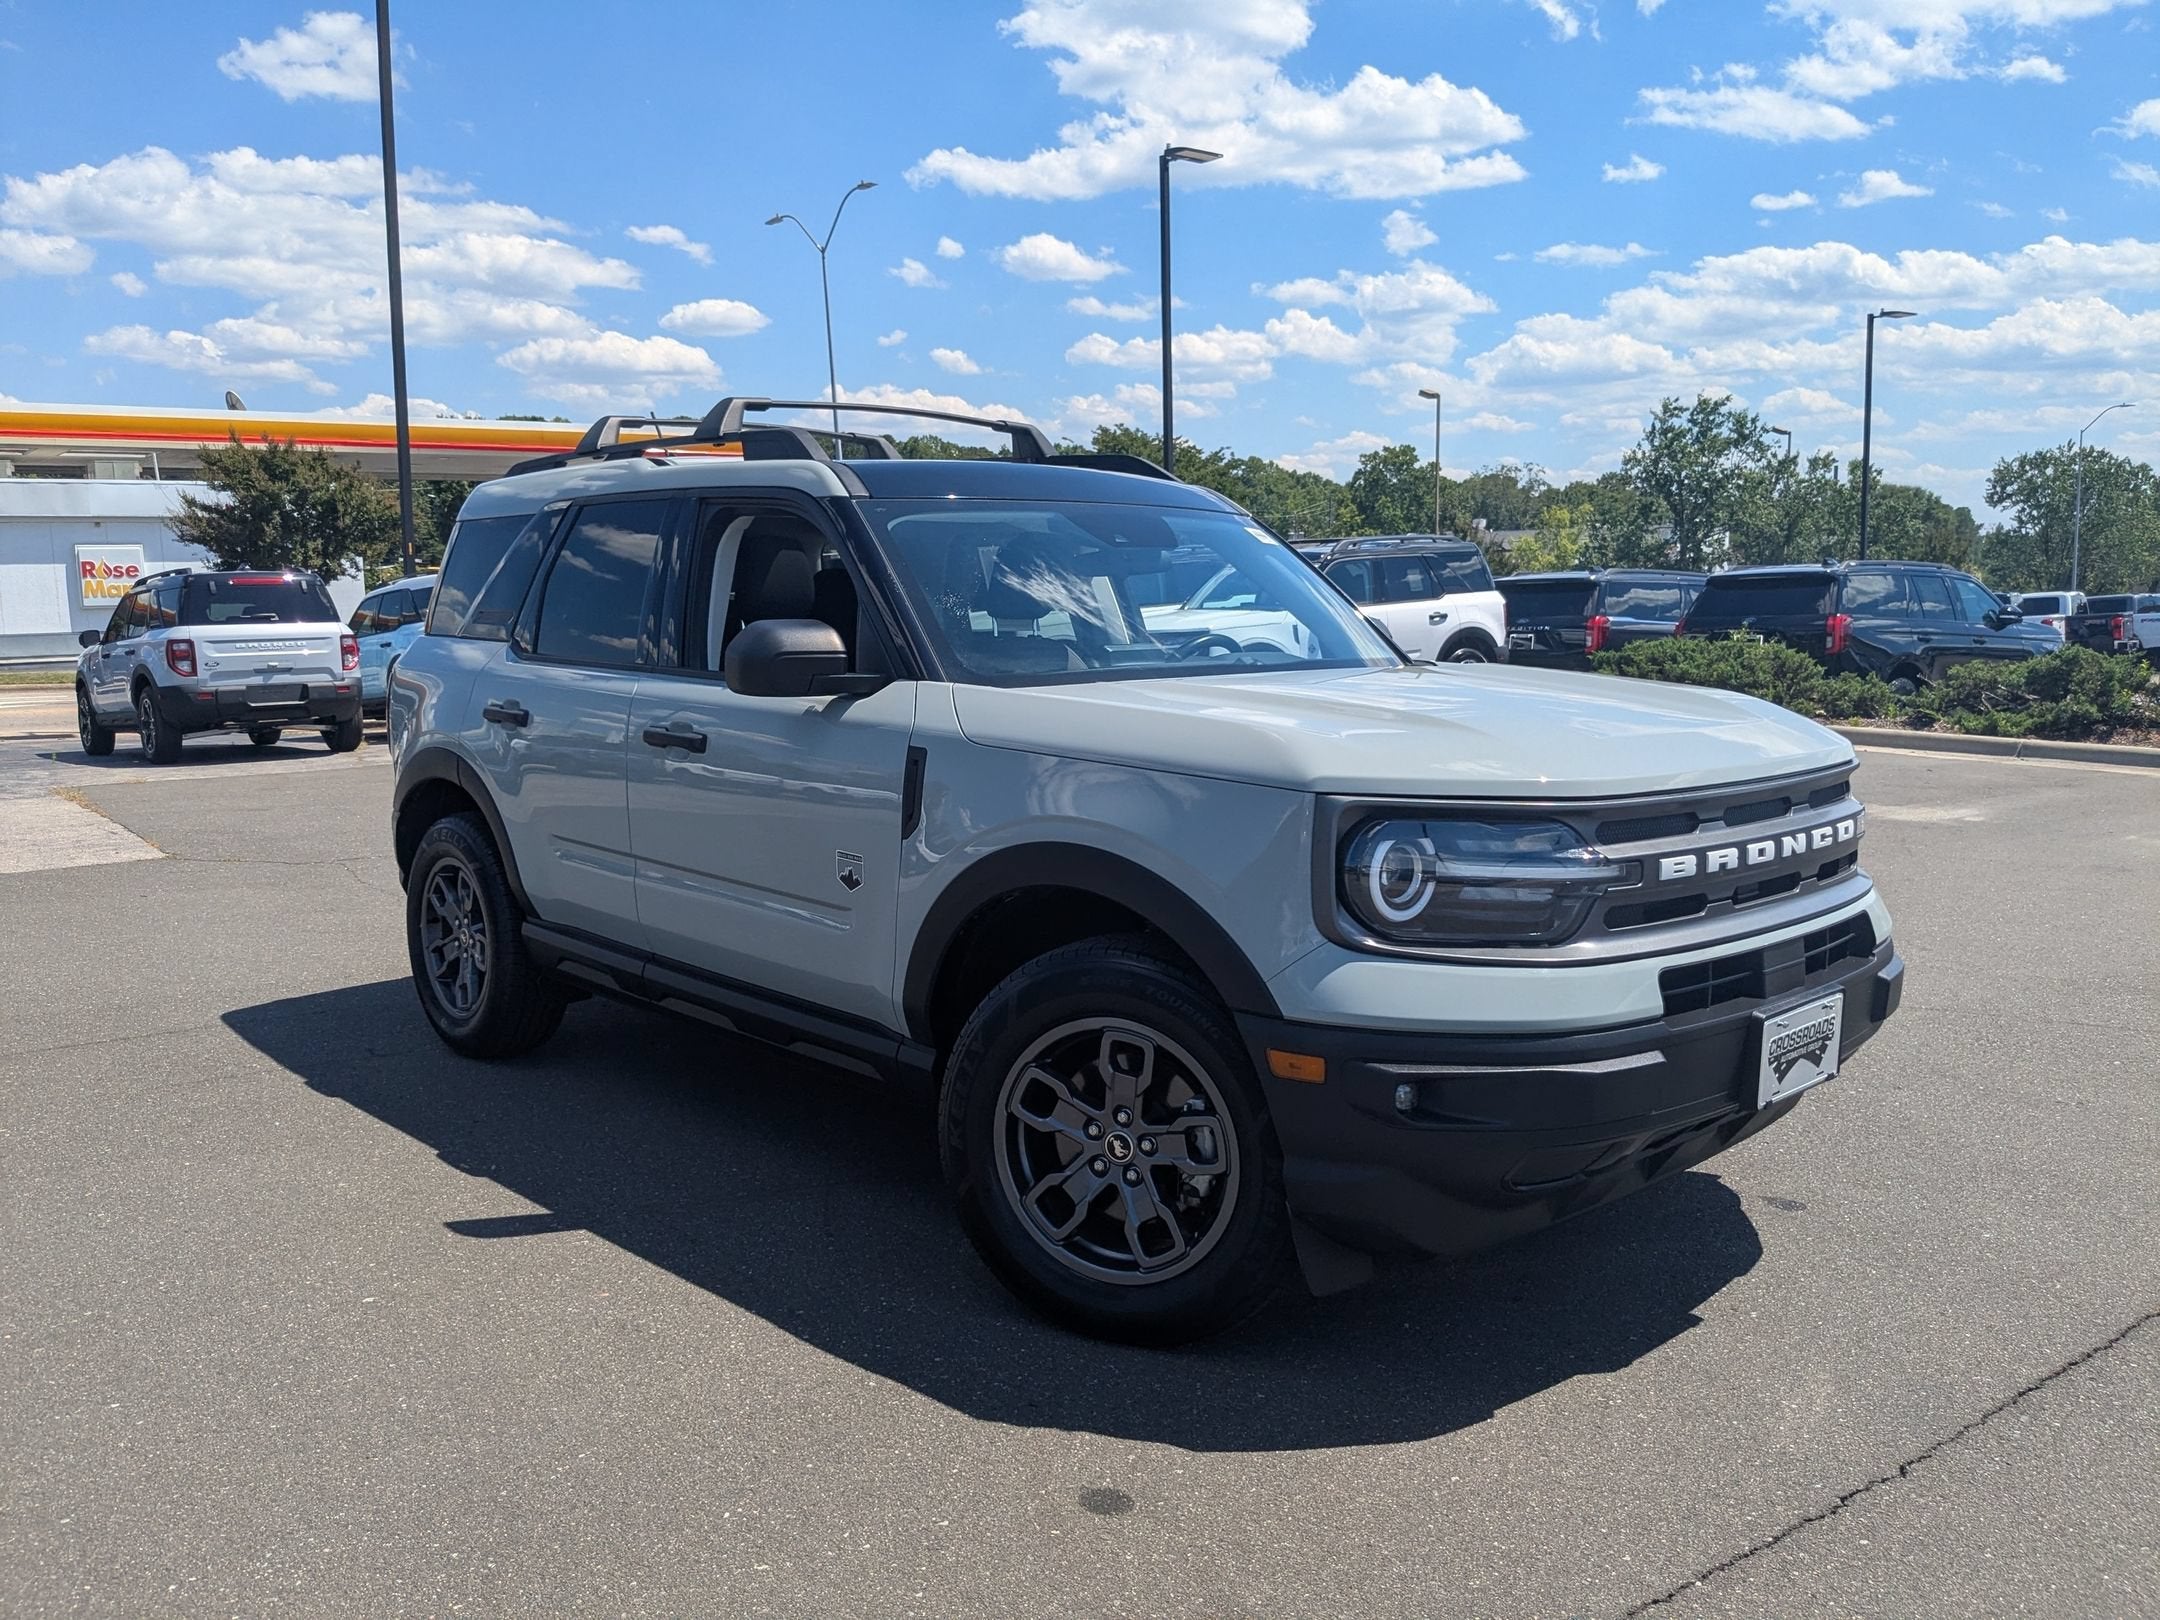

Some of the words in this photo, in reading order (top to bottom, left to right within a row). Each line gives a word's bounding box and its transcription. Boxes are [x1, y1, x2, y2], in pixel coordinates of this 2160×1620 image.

[80, 557, 140, 579] Rose
[84, 579, 133, 598] Mar
[1659, 819, 1855, 881] BRONCO
[1144, 984, 1220, 1039] TOURING
[1769, 1016, 1835, 1056] CROSSROADS
